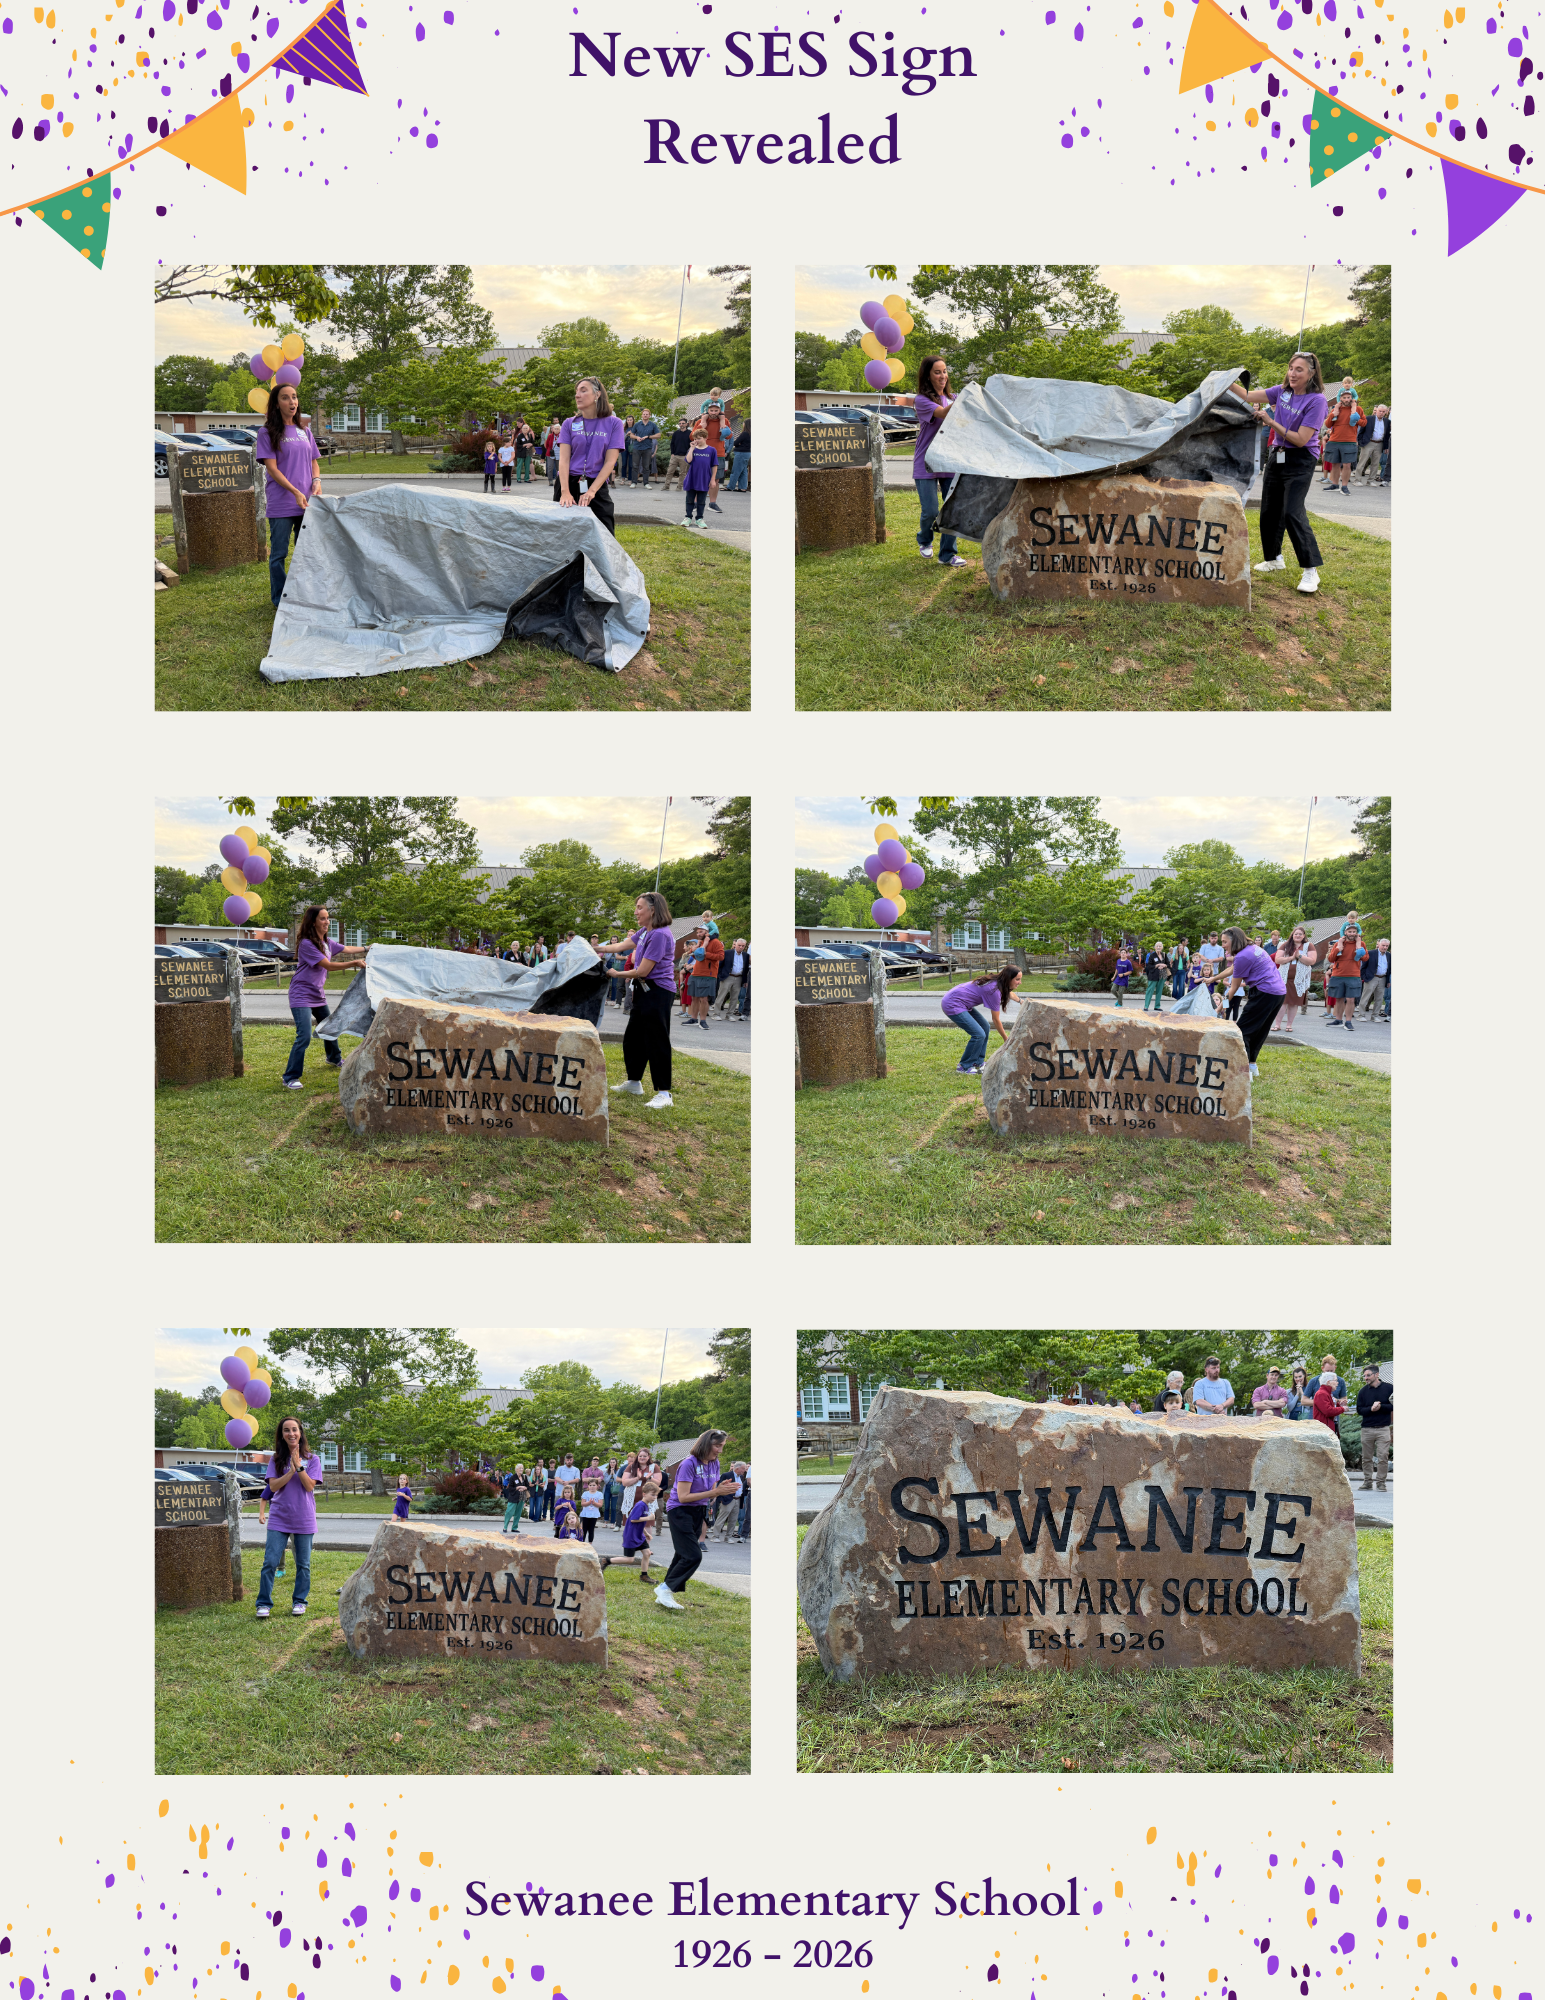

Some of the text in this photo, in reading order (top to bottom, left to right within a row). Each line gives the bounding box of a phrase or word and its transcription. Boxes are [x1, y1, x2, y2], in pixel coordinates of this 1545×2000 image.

[802, 426, 856, 438] SEWANEE
[795, 439, 866, 451] ELEMENTARY
[192, 454, 240, 464] SEWANEE
[810, 452, 854, 464] SCHOOL
[183, 465, 249, 478] ELEMENTARY
[198, 477, 238, 489] SCHOOL
[1029, 506, 1228, 556] SEWANEE
[1029, 554, 1226, 581] ELEMENTARY SCHOOL
[1090, 579, 1156, 594] Est. 1926
[161, 961, 215, 972] SEWANEE
[804, 962, 858, 974] SEWANEE
[796, 974, 868, 987] ELEMENTARY
[168, 986, 212, 998] SCHOOL
[812, 988, 856, 999] SCHOOL
[387, 1041, 586, 1091] SEWANEE
[1029, 1041, 1229, 1091] SEWANEE
[386, 1088, 583, 1116] ELEMENTARY SCHOOL
[1028, 1089, 1227, 1117] ELEMENTARY SCHOOL
[447, 1114, 514, 1129] Est. 1926
[1089, 1114, 1156, 1130] Est. 1926
[158, 1484, 212, 1496] SEWANEE
[155, 1496, 222, 1509] LEMENTARY
[165, 1510, 210, 1522] SCHOOL
[890, 1476, 1313, 1565] SEWANEE
[386, 1564, 585, 1613] SEWANEE
[894, 1577, 1308, 1618] ELEMENTARY SCHOOL
[386, 1611, 583, 1638] ELEMENTARY SCHOOL
[447, 1636, 513, 1652] Est. 1926
[1027, 1629, 1166, 1654] Est. 1926
